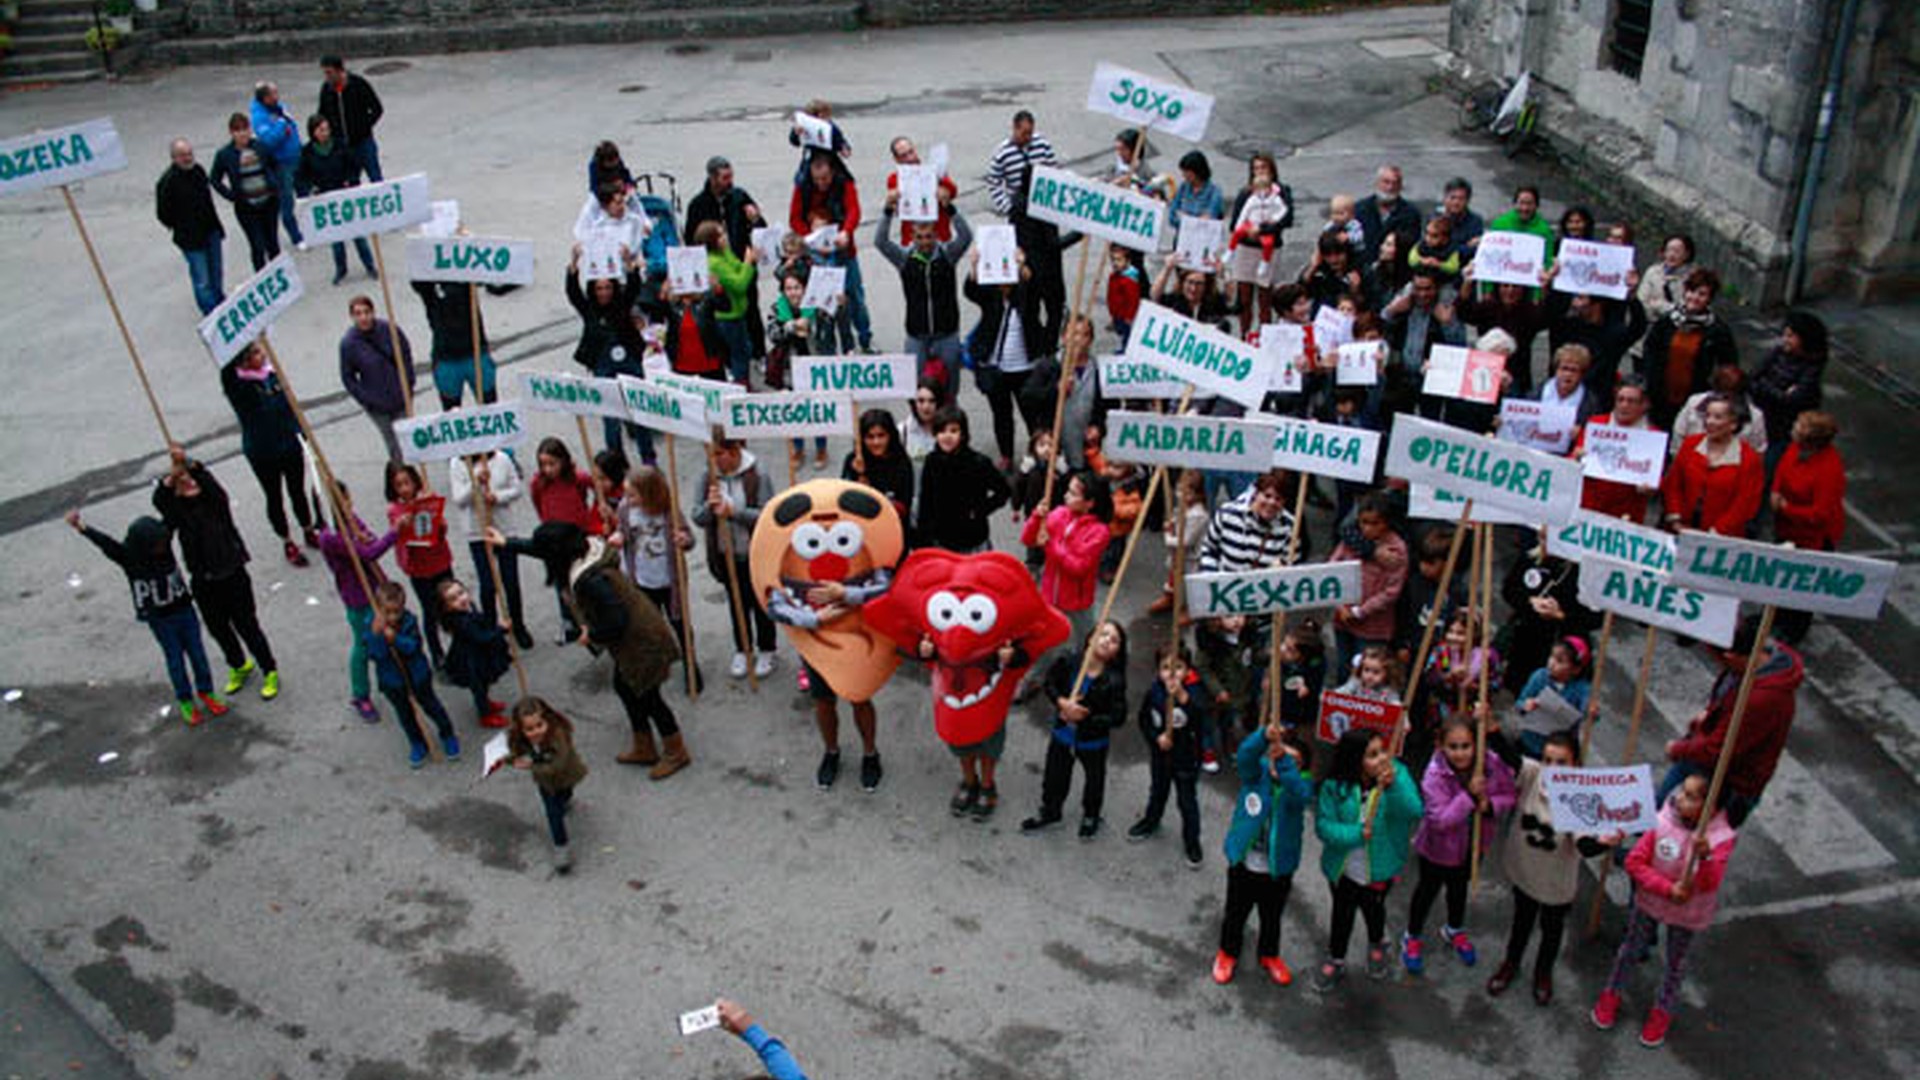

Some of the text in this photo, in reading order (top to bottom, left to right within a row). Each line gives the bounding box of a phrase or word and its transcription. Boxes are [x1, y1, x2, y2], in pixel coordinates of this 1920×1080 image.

[1109, 78, 1184, 120] SOXO
[311, 183, 404, 231] BEOTEGI
[433, 244, 511, 271] LUXO
[214, 268, 292, 345] ERRETES
[810, 362, 894, 389] MURGA
[411, 411, 520, 451] OLABEZAR
[730, 399, 838, 427] ETXEGOIEN
[1117, 422, 1246, 456] MADARIA
[1408, 436, 1553, 502] OPELLORA
[1688, 544, 1866, 600] LLANTENO
[1208, 575, 1343, 614] KEXAA
[1602, 569, 1705, 621] AÑES
